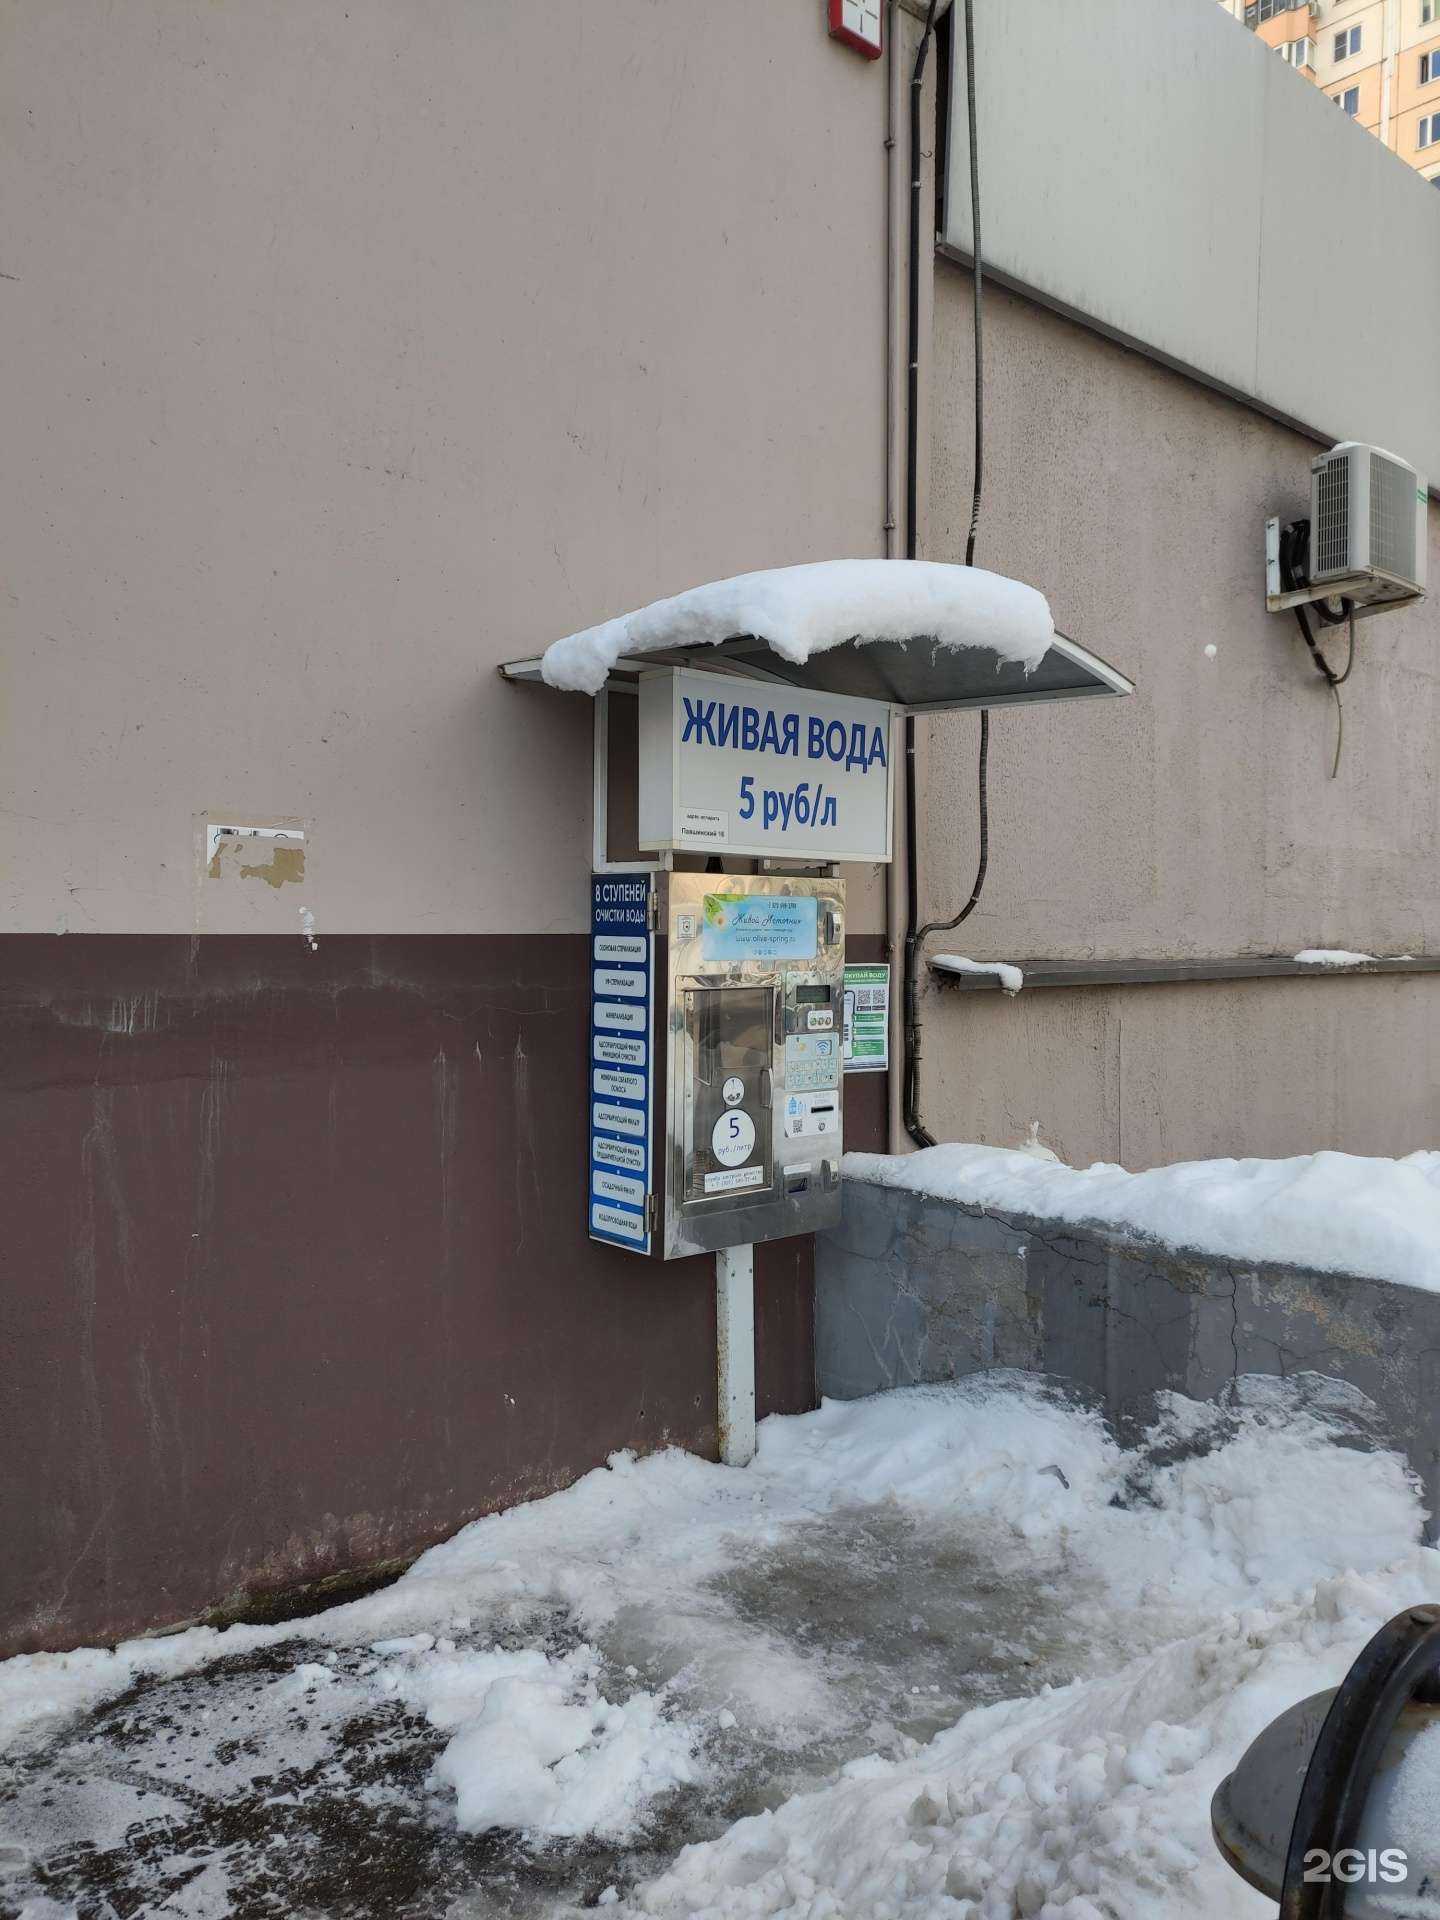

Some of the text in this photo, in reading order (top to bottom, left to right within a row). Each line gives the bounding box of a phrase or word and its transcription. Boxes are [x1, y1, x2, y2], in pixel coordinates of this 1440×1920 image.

[682, 697, 887, 774] ЖИВАЯ ВОДА
[739, 776, 837, 831] 5 руб/л
[595, 880, 646, 902] 8 СТУПЕНЕЙ
[595, 909, 646, 924] ОЧИСТКИ ВОДЫ
[729, 1117, 740, 1139] 5
